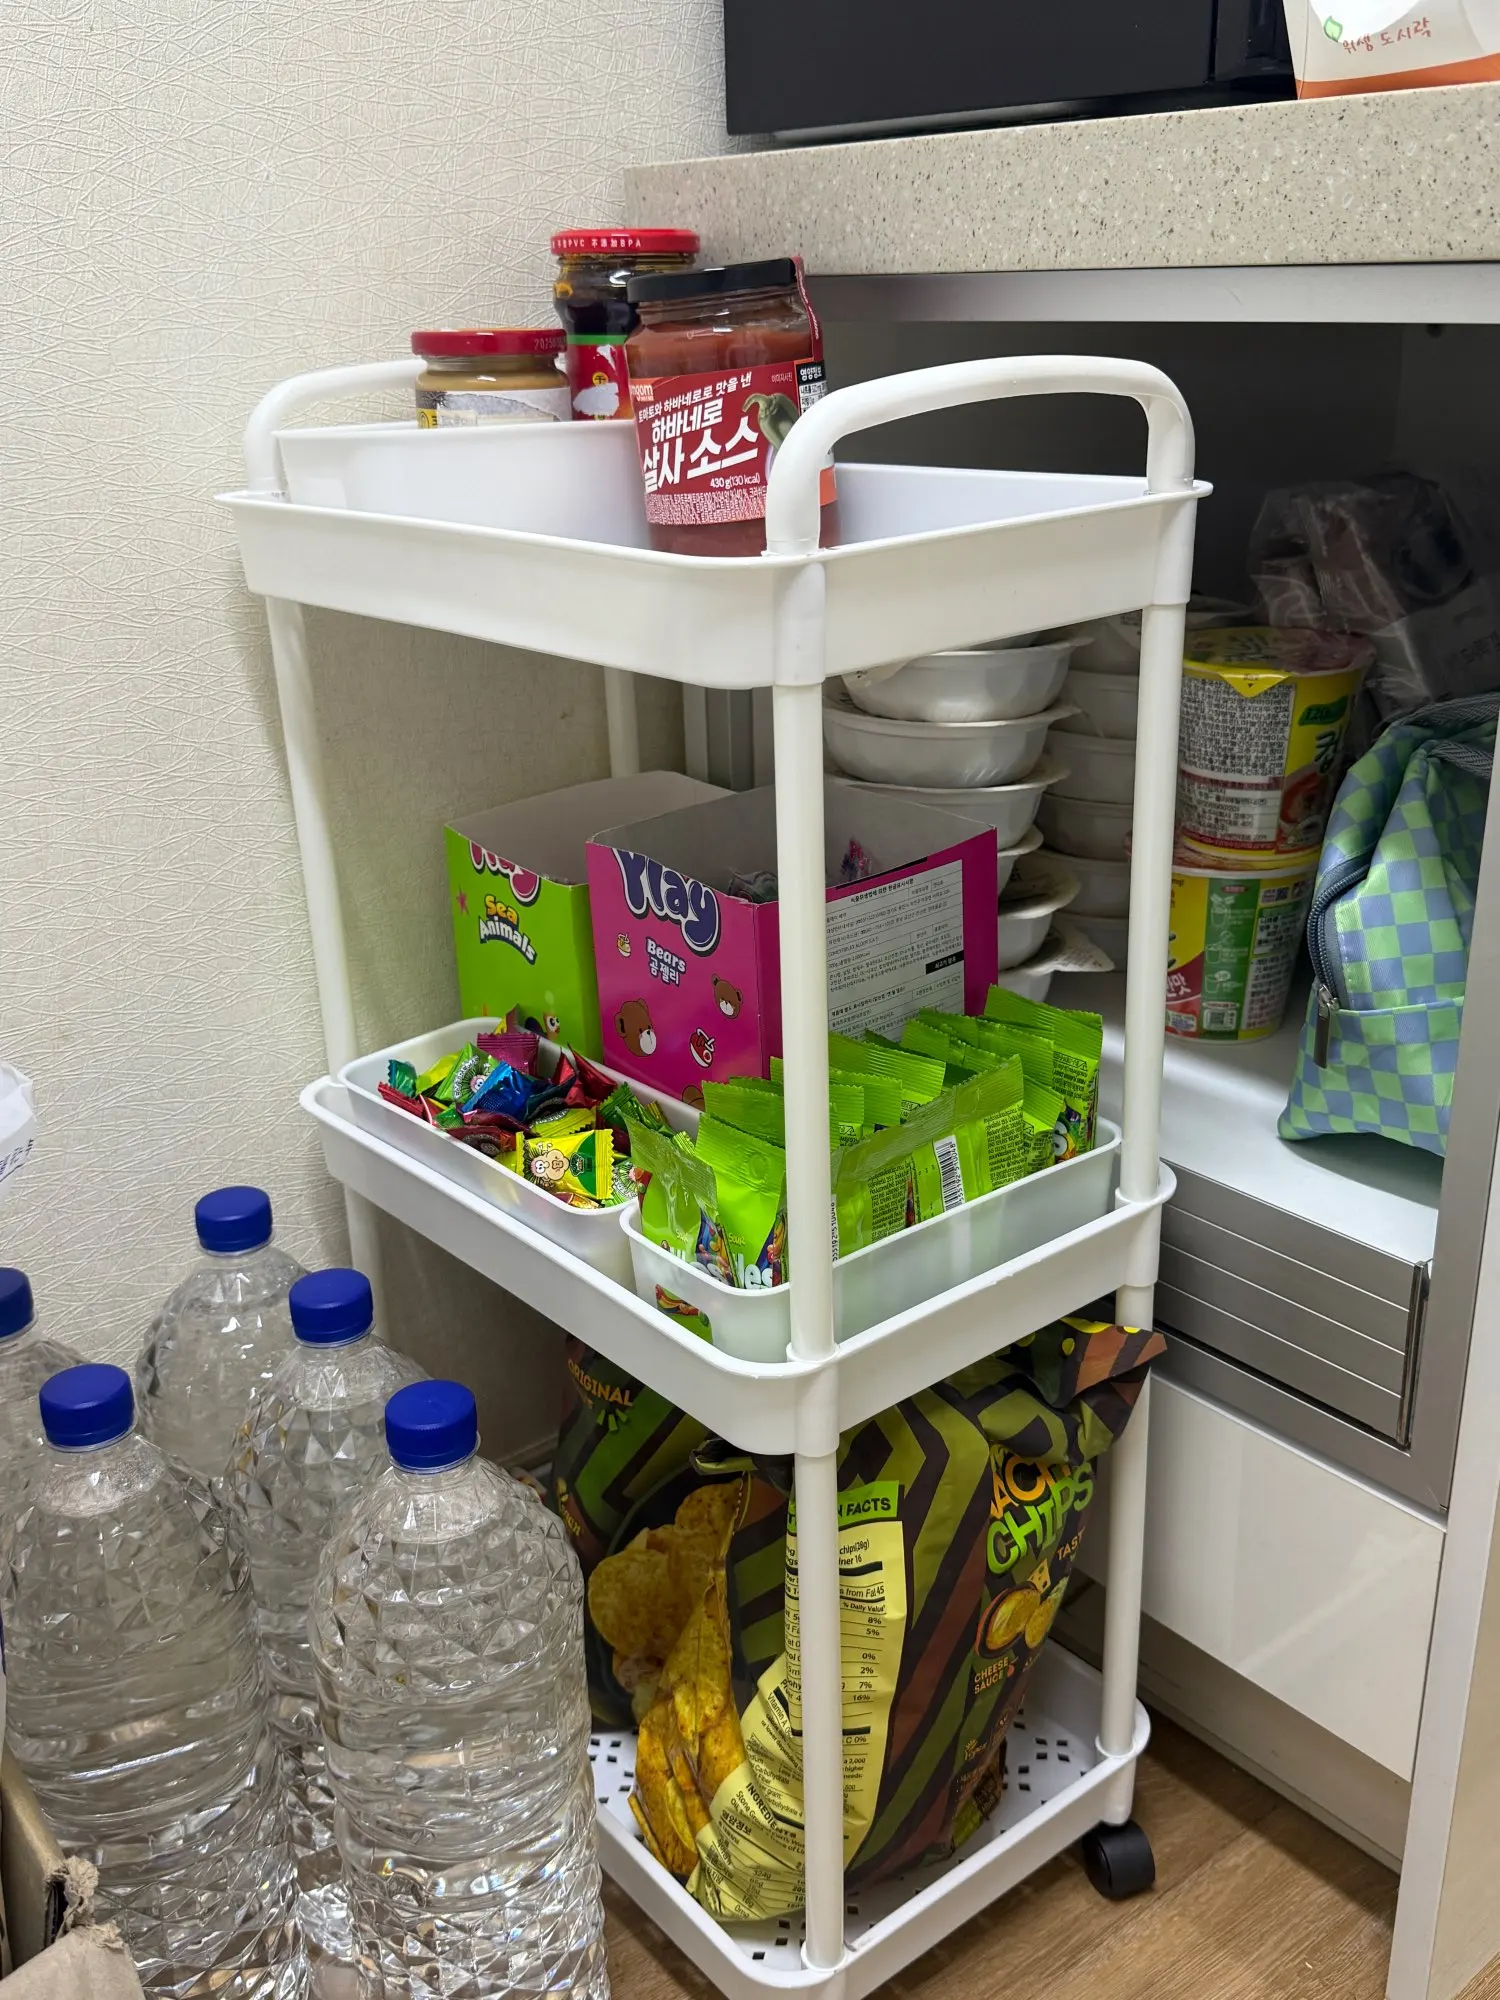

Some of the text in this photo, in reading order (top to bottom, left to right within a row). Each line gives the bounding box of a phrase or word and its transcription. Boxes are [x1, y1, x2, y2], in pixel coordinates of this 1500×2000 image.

[638, 371, 752, 423] 토마토와 하바네로로 맛을 낸
[652, 398, 723, 444] 하바네로
[643, 416, 759, 494] 살사 소스
[710, 477, 725, 489] 430
[485, 894, 519, 926] Sea
[479, 916, 537, 965] Animals
[647, 938, 687, 973] Bears
[567, 1358, 633, 1407] ORIGINAL
[846, 1497, 891, 1517] FACTS
[986, 1462, 1094, 1575] CHIPS
[854, 1554, 863, 1564] 16
[846, 1589, 864, 1598] from
[876, 1585, 885, 1595] 45
[850, 1602, 866, 1612] Daily
[868, 1617, 882, 1625] 8%
[866, 1628, 880, 1636] 5%
[862, 1652, 876, 1660] 0%
[860, 1666, 874, 1674] 2%
[974, 1656, 1009, 1683] CHEESE
[859, 1681, 873, 1689] 7%
[974, 1670, 1005, 1695] SAUCE
[767, 1692, 785, 1721] Vitamin
[781, 1719, 788, 1728] A
[845, 1736, 867, 1744] C 0%
[844, 1765, 864, 1773] higher
[735, 1790, 751, 1813] Stone
